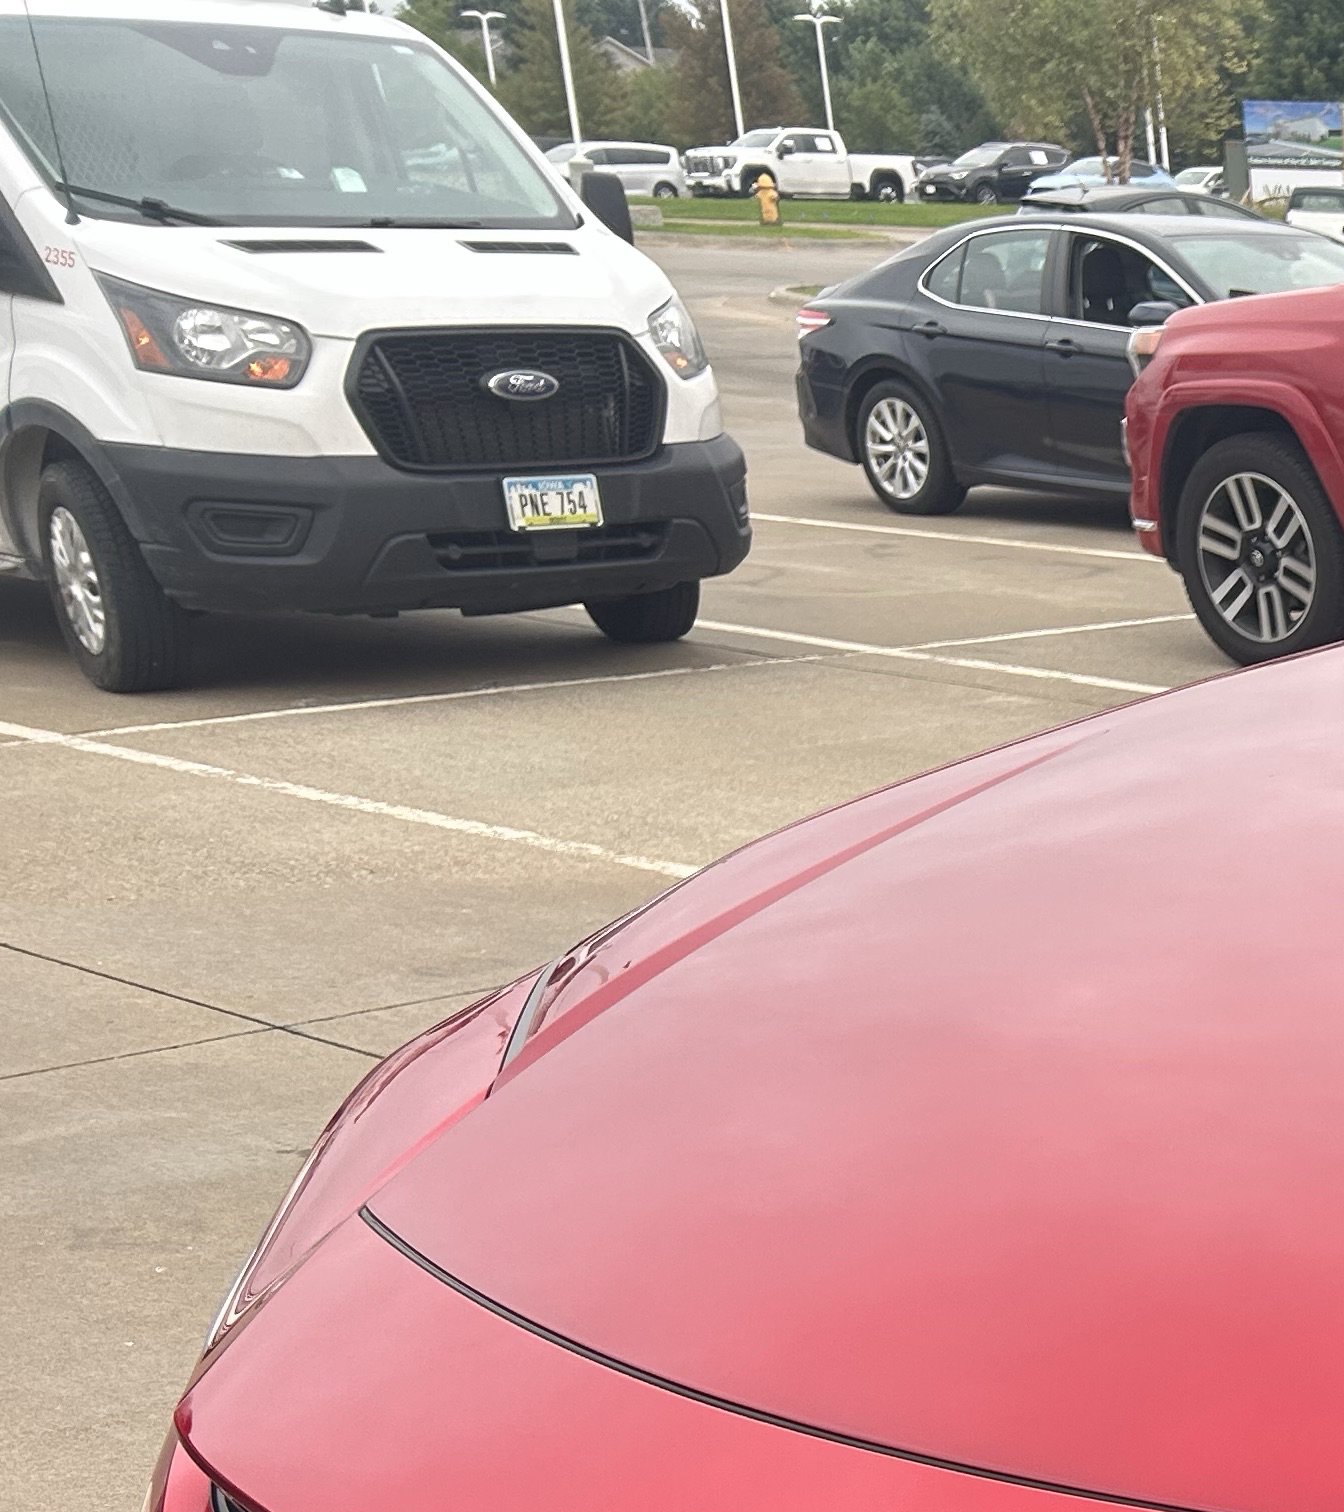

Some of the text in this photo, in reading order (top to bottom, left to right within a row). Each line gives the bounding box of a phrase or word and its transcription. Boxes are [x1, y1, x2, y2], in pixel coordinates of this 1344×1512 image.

[45, 246, 75, 268] 2355
[519, 491, 587, 518] PNE 754
